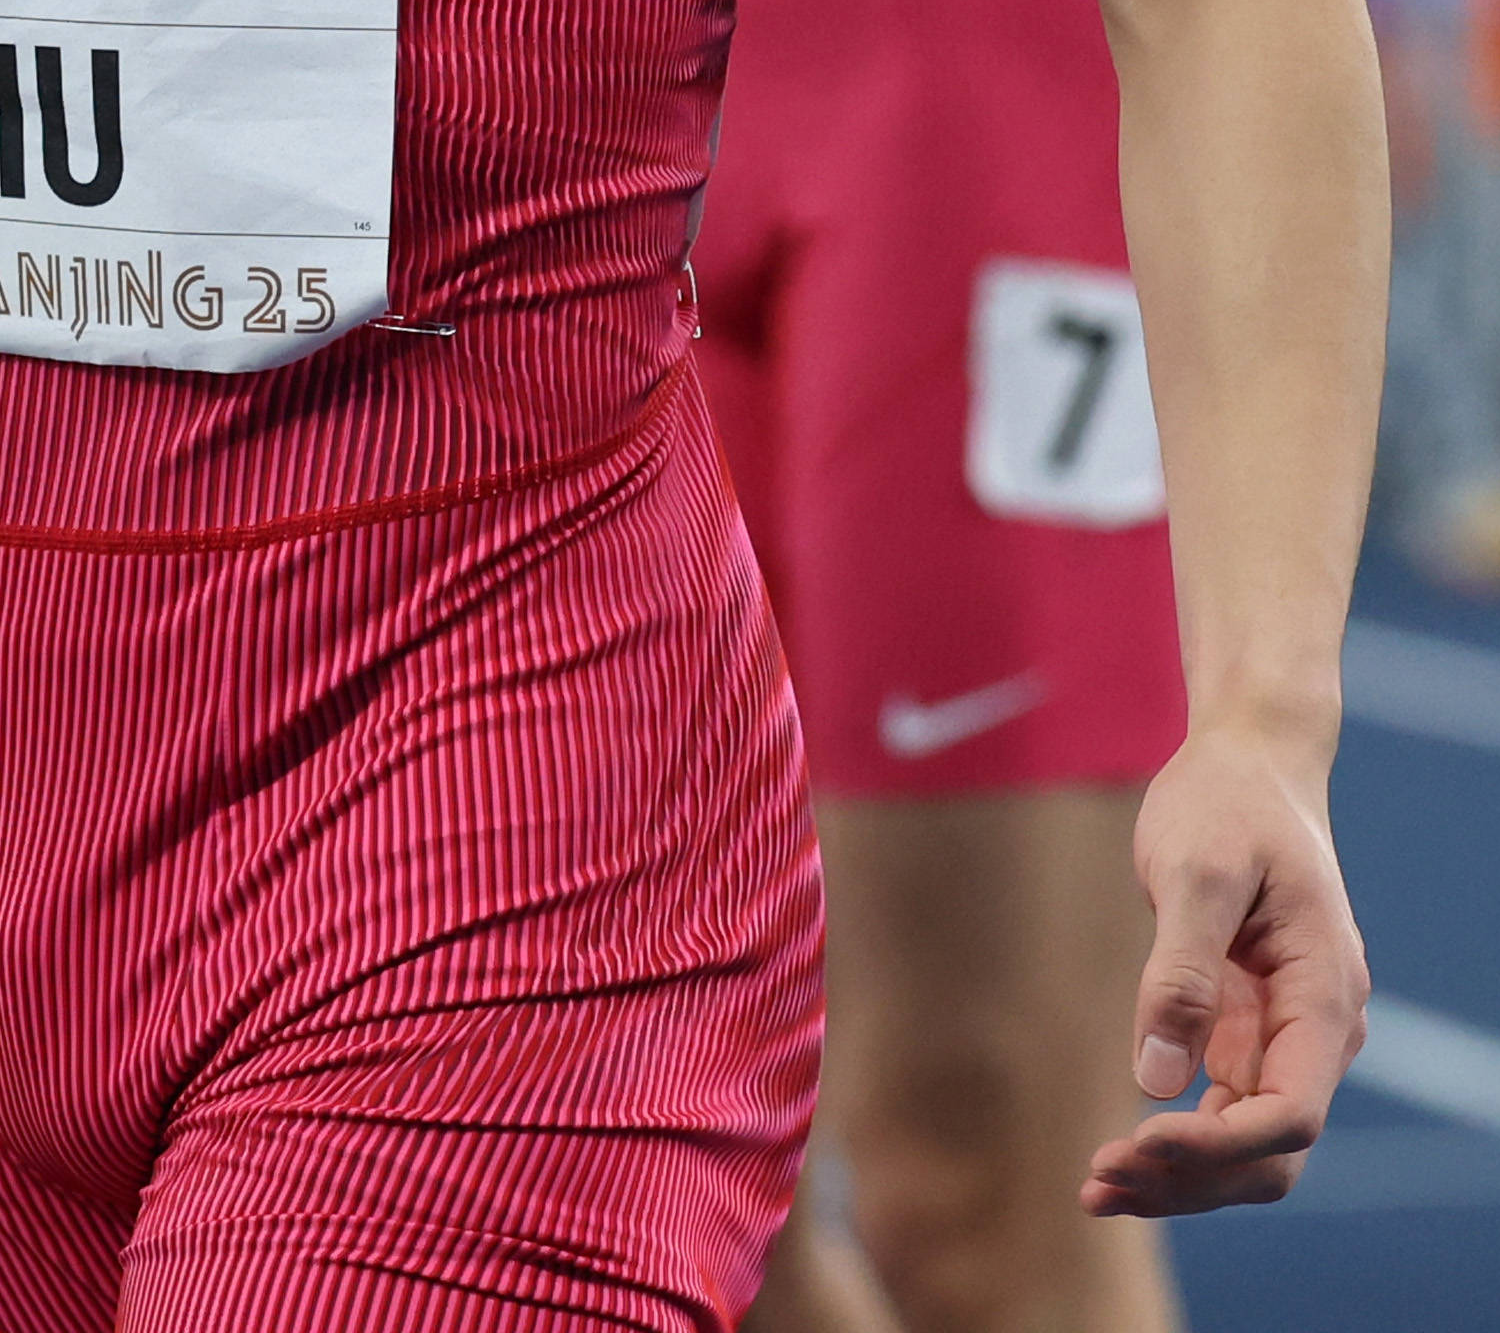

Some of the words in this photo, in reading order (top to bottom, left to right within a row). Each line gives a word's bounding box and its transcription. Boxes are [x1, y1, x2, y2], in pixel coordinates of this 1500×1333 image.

[353, 221, 371, 231] 145
[242, 265, 336, 334] 25
[1042, 307, 1116, 478] 7
